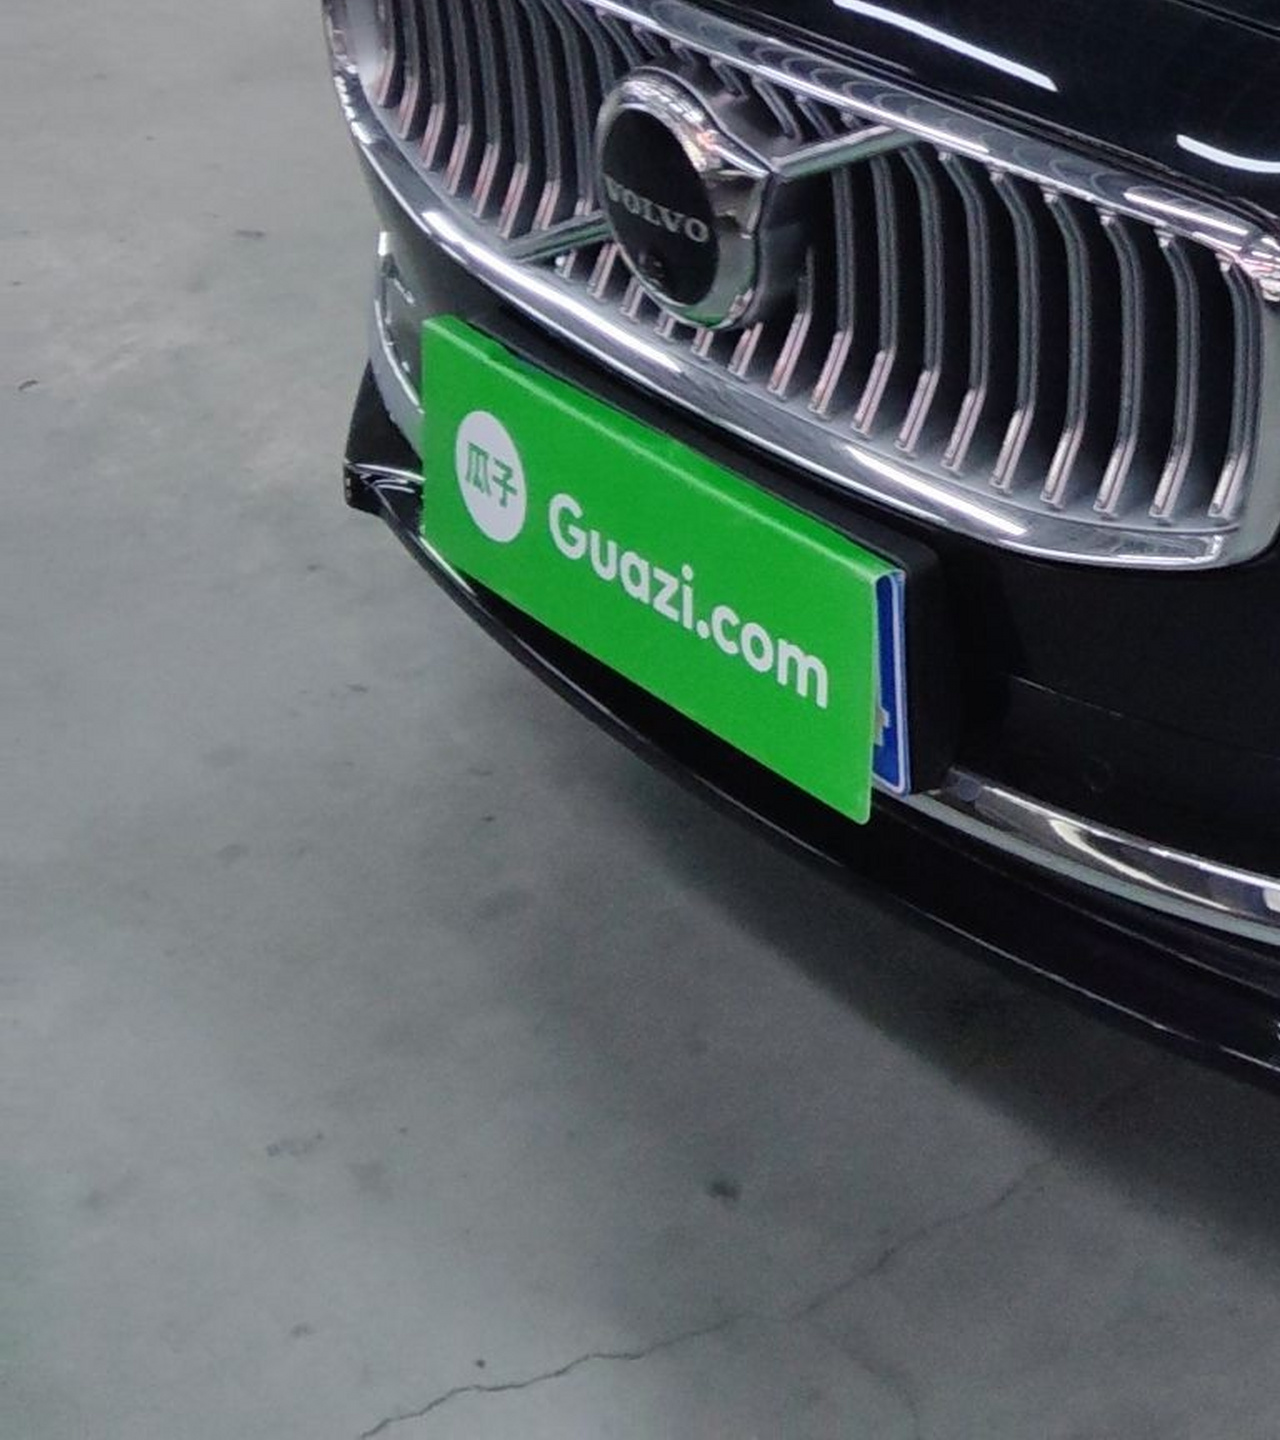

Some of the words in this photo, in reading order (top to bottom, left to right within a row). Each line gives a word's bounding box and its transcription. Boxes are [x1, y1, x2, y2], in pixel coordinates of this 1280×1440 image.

[602, 172, 709, 243] VOLVO
[466, 442, 519, 508] 瓜子
[548, 492, 829, 710] Guazi.com
